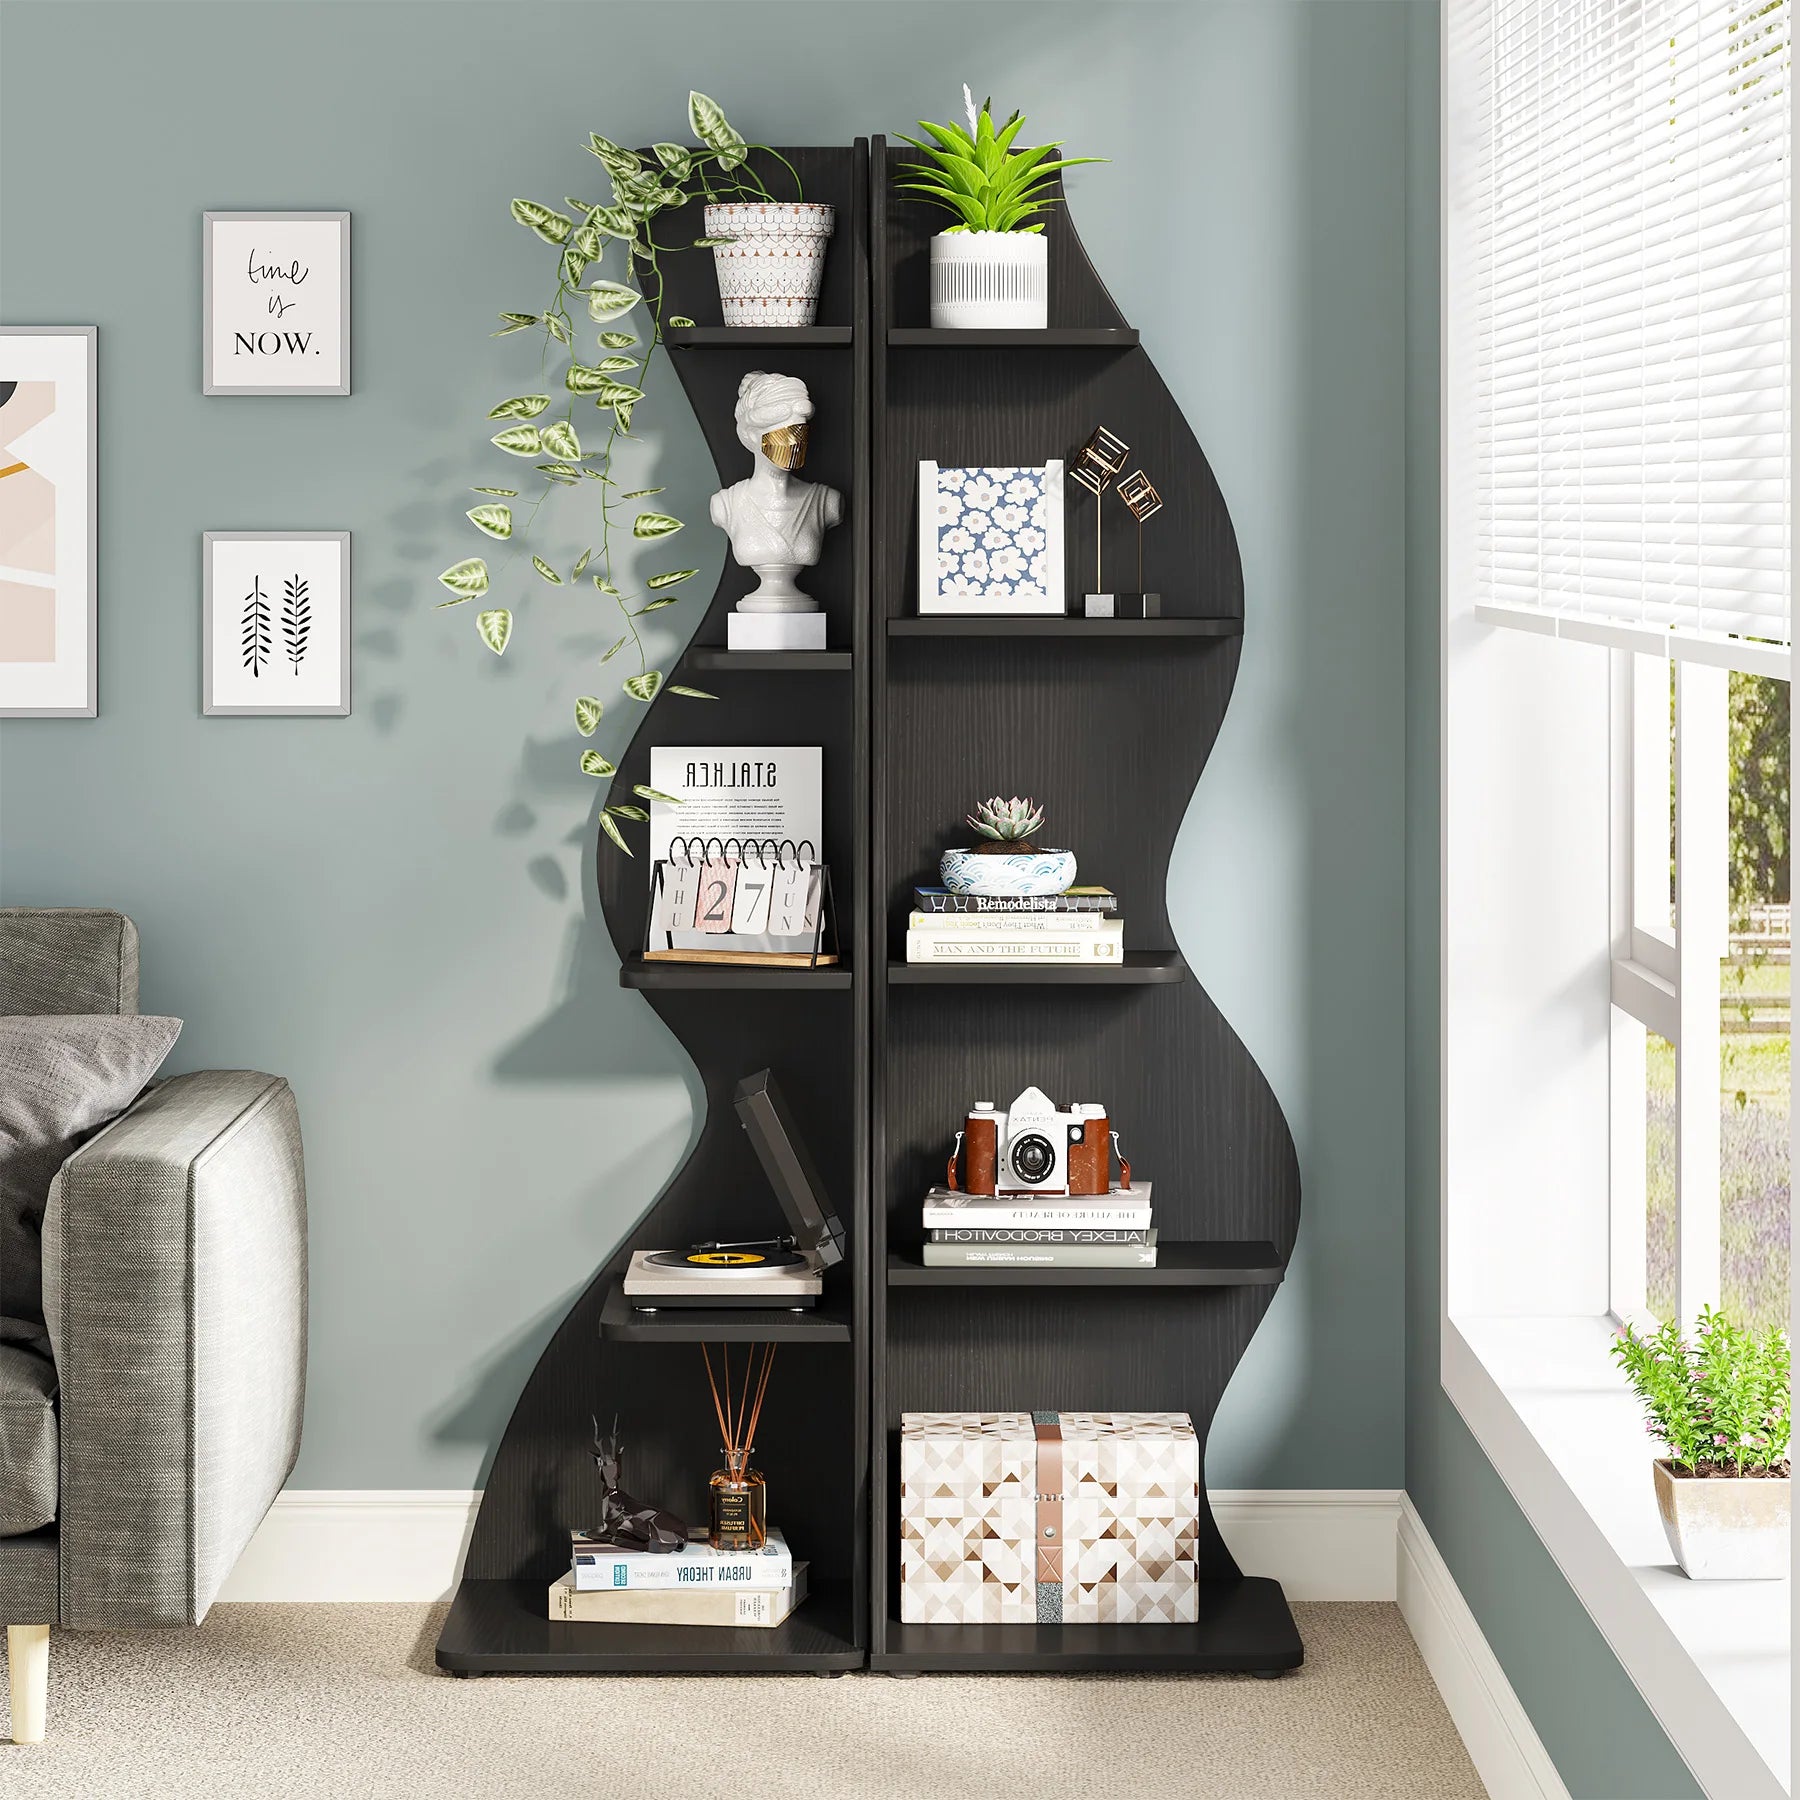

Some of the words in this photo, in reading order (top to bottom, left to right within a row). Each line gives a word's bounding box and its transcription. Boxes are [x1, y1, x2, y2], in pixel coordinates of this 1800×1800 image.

[247, 248, 309, 285] time
[268, 289, 296, 319] is
[234, 331, 321, 356] NOW.
[977, 897, 1058, 912] Remodelista
[933, 945, 963, 954] MAN
[967, 945, 995, 954] AND
[998, 945, 1025, 954] THE
[1030, 945, 1081, 954] FUTURE
